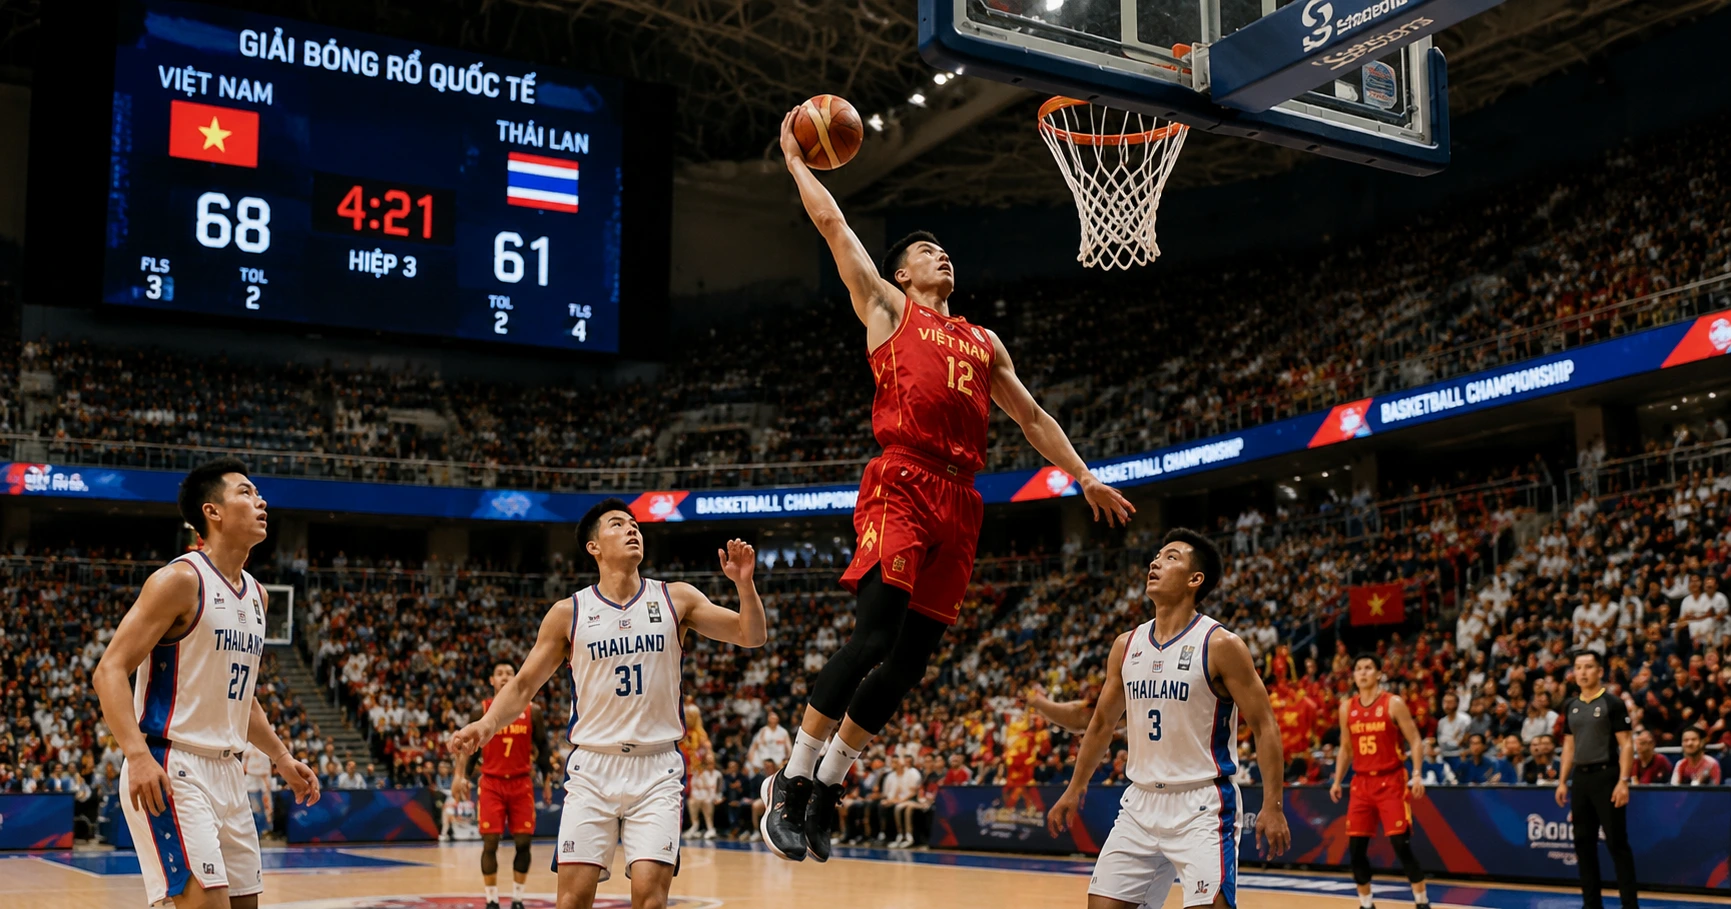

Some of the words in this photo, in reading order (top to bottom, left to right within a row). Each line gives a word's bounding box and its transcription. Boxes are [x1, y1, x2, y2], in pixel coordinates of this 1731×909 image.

[240, 27, 295, 64] GIẢI
[429, 61, 500, 98] QUỐC
[505, 71, 536, 104] TẾ
[158, 65, 212, 97] VIỆT
[219, 75, 273, 106] NAM
[549, 128, 589, 154] LAN
[195, 191, 271, 253] 68
[337, 185, 433, 239] 4:21
[140, 256, 170, 273] FLS
[402, 255, 417, 278] 3
[493, 231, 549, 286] 61
[145, 274, 163, 300] 3
[239, 266, 268, 284] TOL
[245, 285, 261, 310] 2
[488, 294, 514, 310] TOL
[494, 311, 509, 335] 2
[571, 319, 587, 342] 4
[958, 338, 990, 369] NAM
[946, 356, 974, 397] 12
[1380, 386, 1465, 424] BASKETBALL
[1465, 359, 1575, 404] CHAMPIONSHIP
[1163, 437, 1244, 473] CHAMPIONSHIP
[695, 494, 782, 514] BASKETBALL
[587, 634, 665, 661] THAILAND
[227, 662, 251, 701] 27
[614, 663, 643, 697] 31
[1126, 680, 1190, 702] THAILAND
[1148, 709, 1162, 741] 3
[502, 737, 514, 758] 7
[1358, 734, 1377, 755] 65
